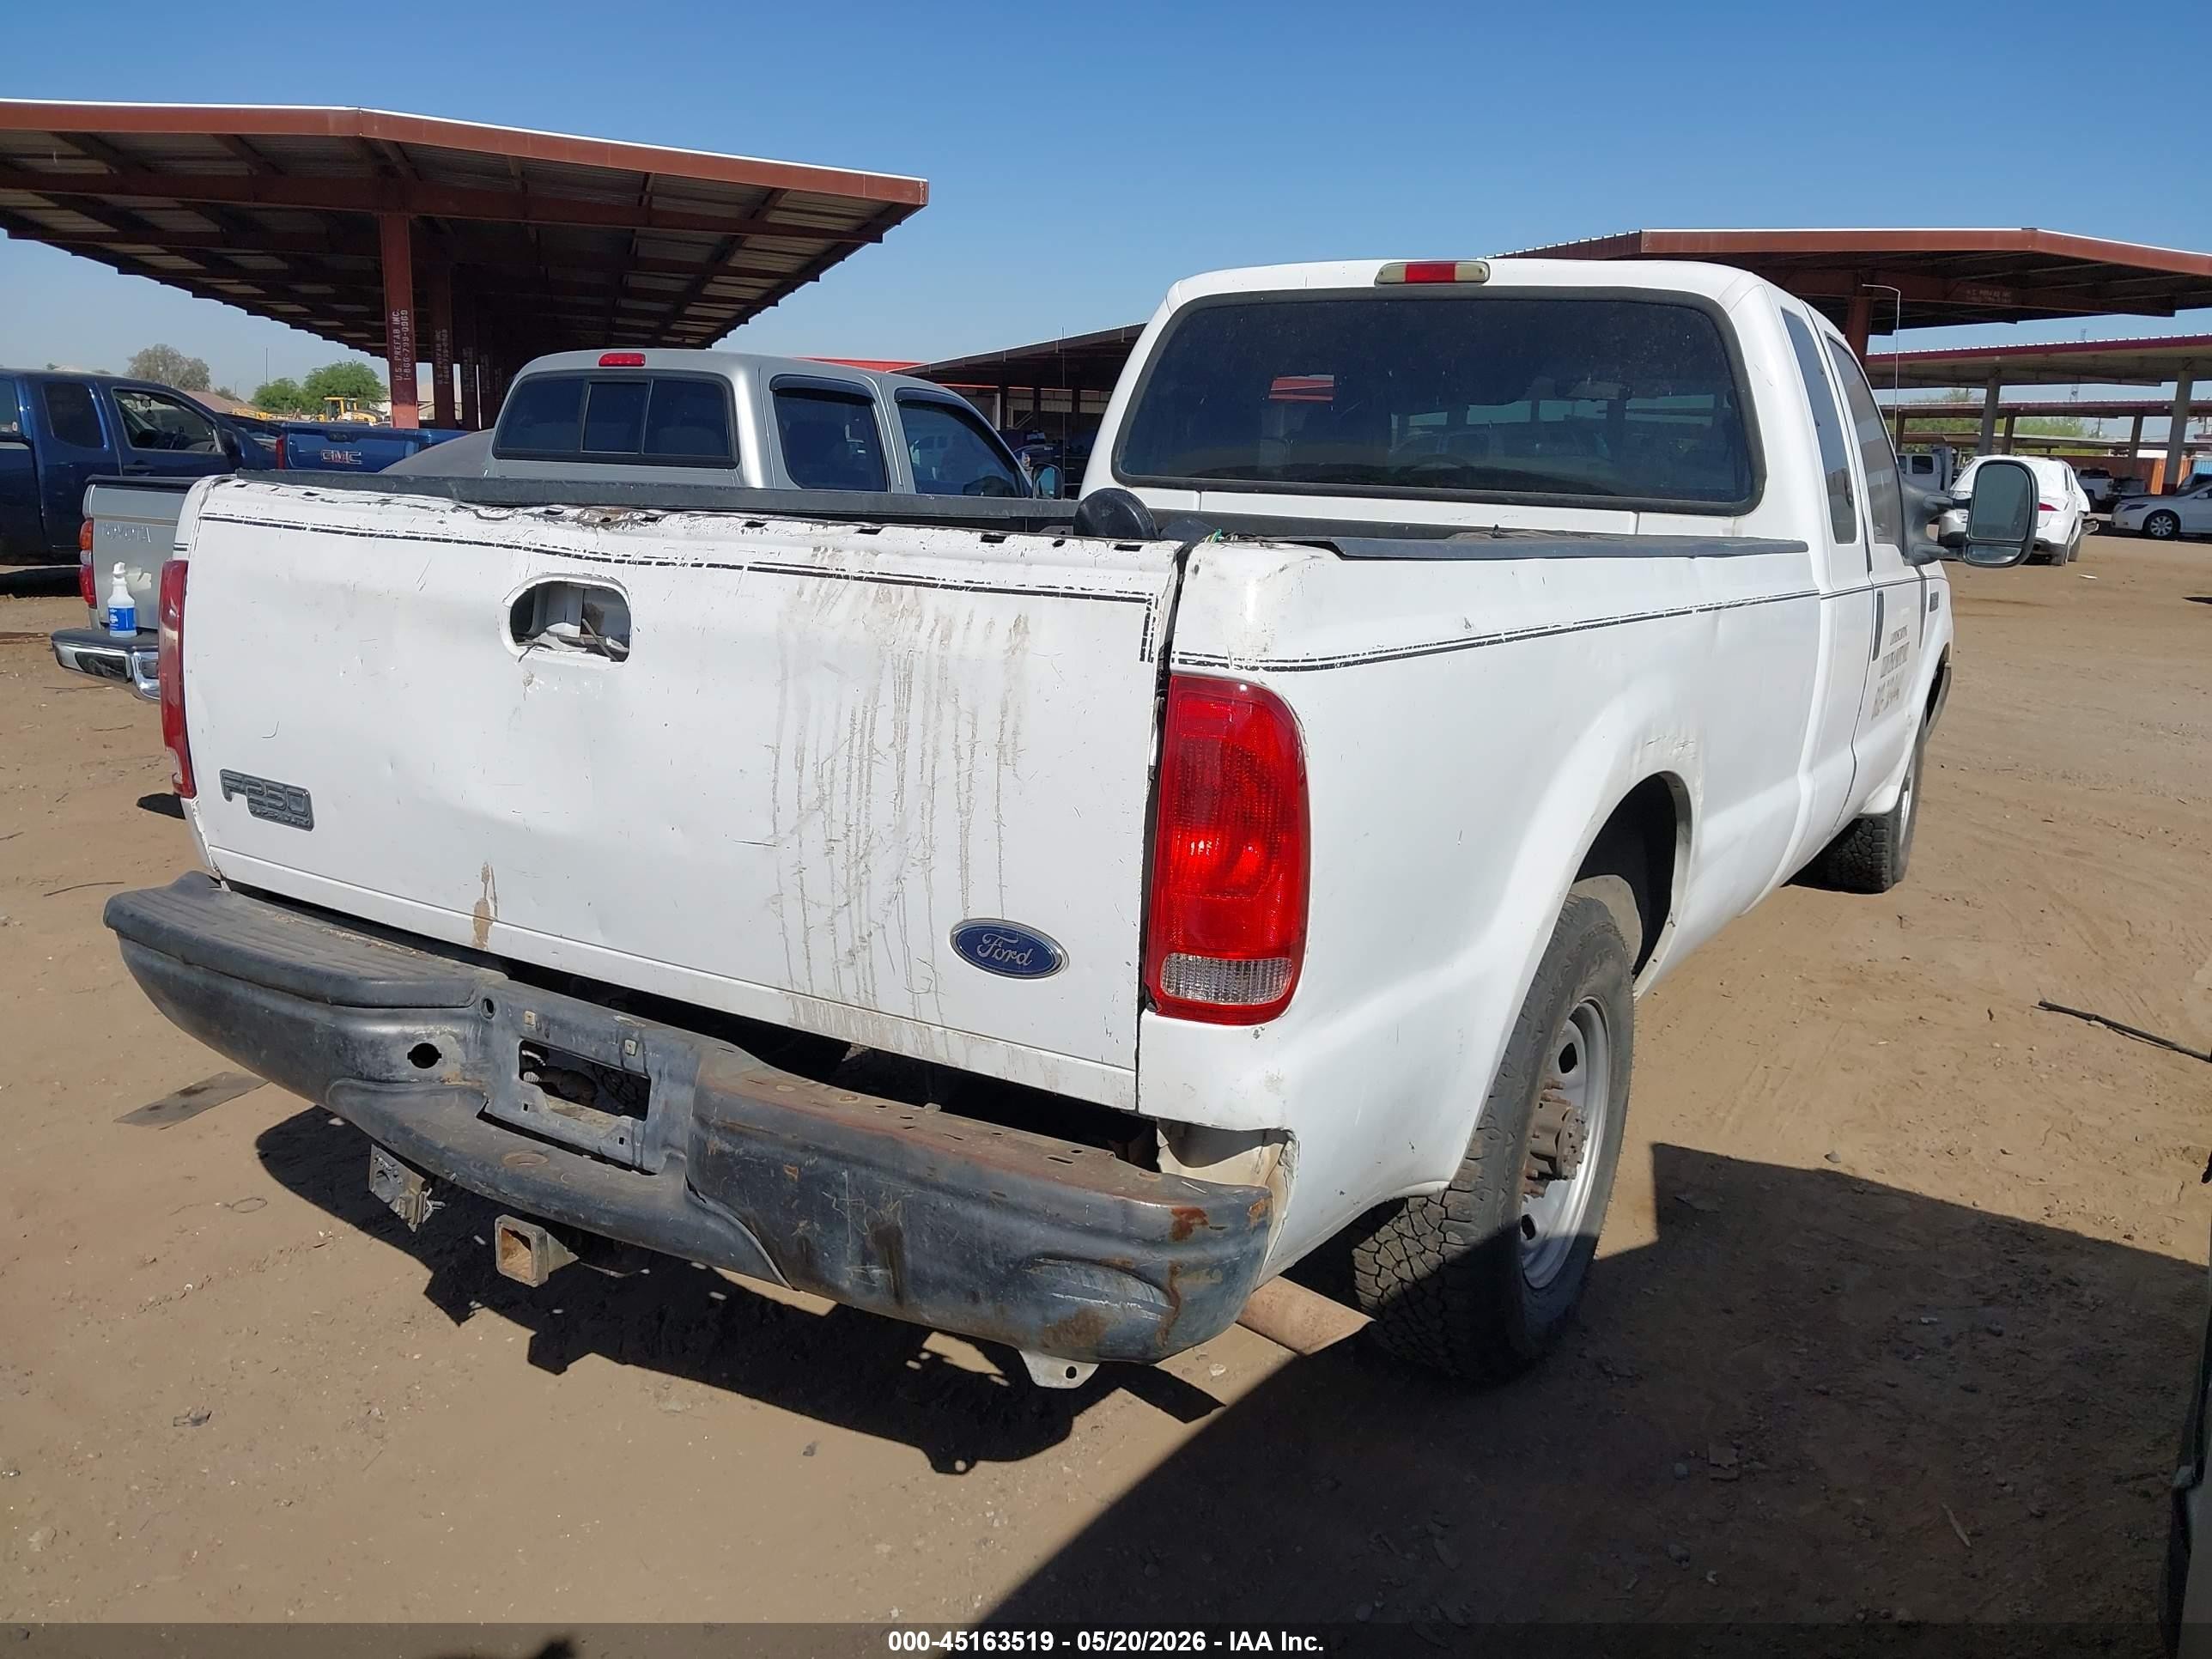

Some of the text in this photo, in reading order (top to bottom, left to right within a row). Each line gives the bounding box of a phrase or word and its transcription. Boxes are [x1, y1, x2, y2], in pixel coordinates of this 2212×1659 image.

[392, 309, 400, 325] INC.
[392, 329, 402, 361] PREFAB
[320, 449, 362, 465] GMC
[976, 932, 1033, 967] Ford
